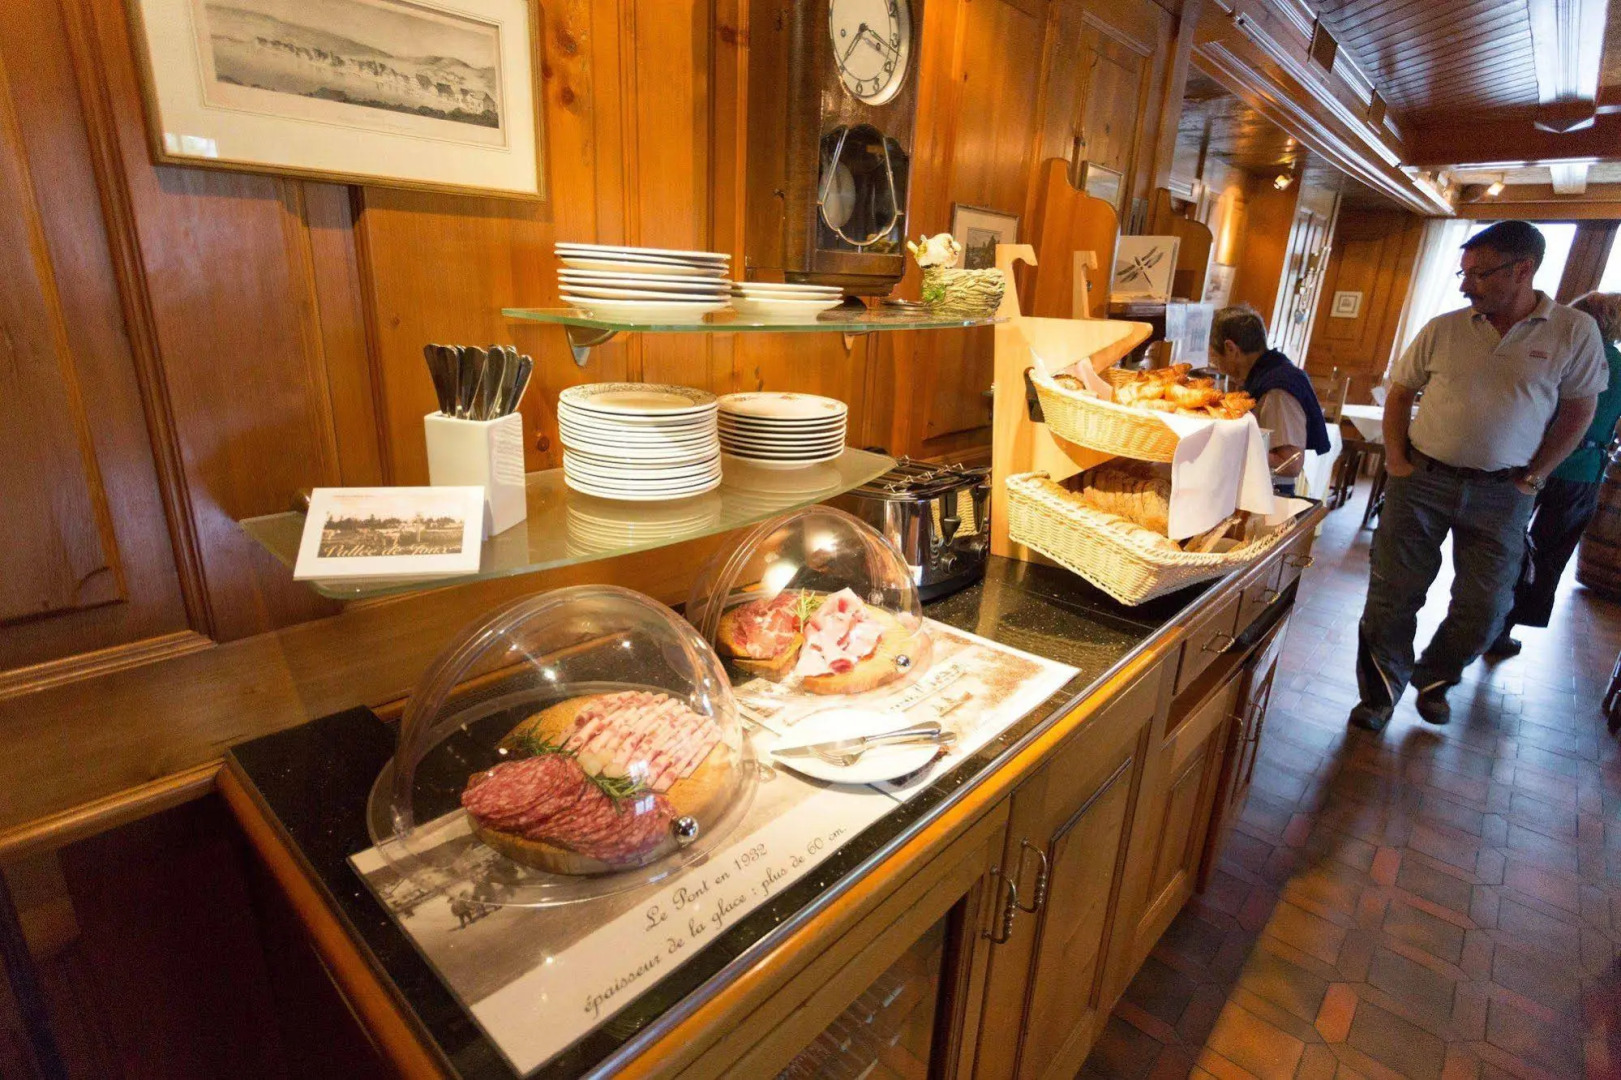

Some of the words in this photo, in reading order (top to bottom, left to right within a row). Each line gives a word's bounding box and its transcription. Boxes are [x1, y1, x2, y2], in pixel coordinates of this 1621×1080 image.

[584, 955, 661, 1020] épaisseur
[667, 938, 685, 954] de
[688, 918, 706, 939] la
[711, 894, 748, 928] glace
[761, 864, 788, 897] plus
[789, 854, 805, 869] de
[806, 837, 825, 856] 60
[644, 905, 669, 932] Le
[672, 880, 710, 911] Pont
[715, 871, 731, 885] en
[734, 843, 768, 872] 1932
